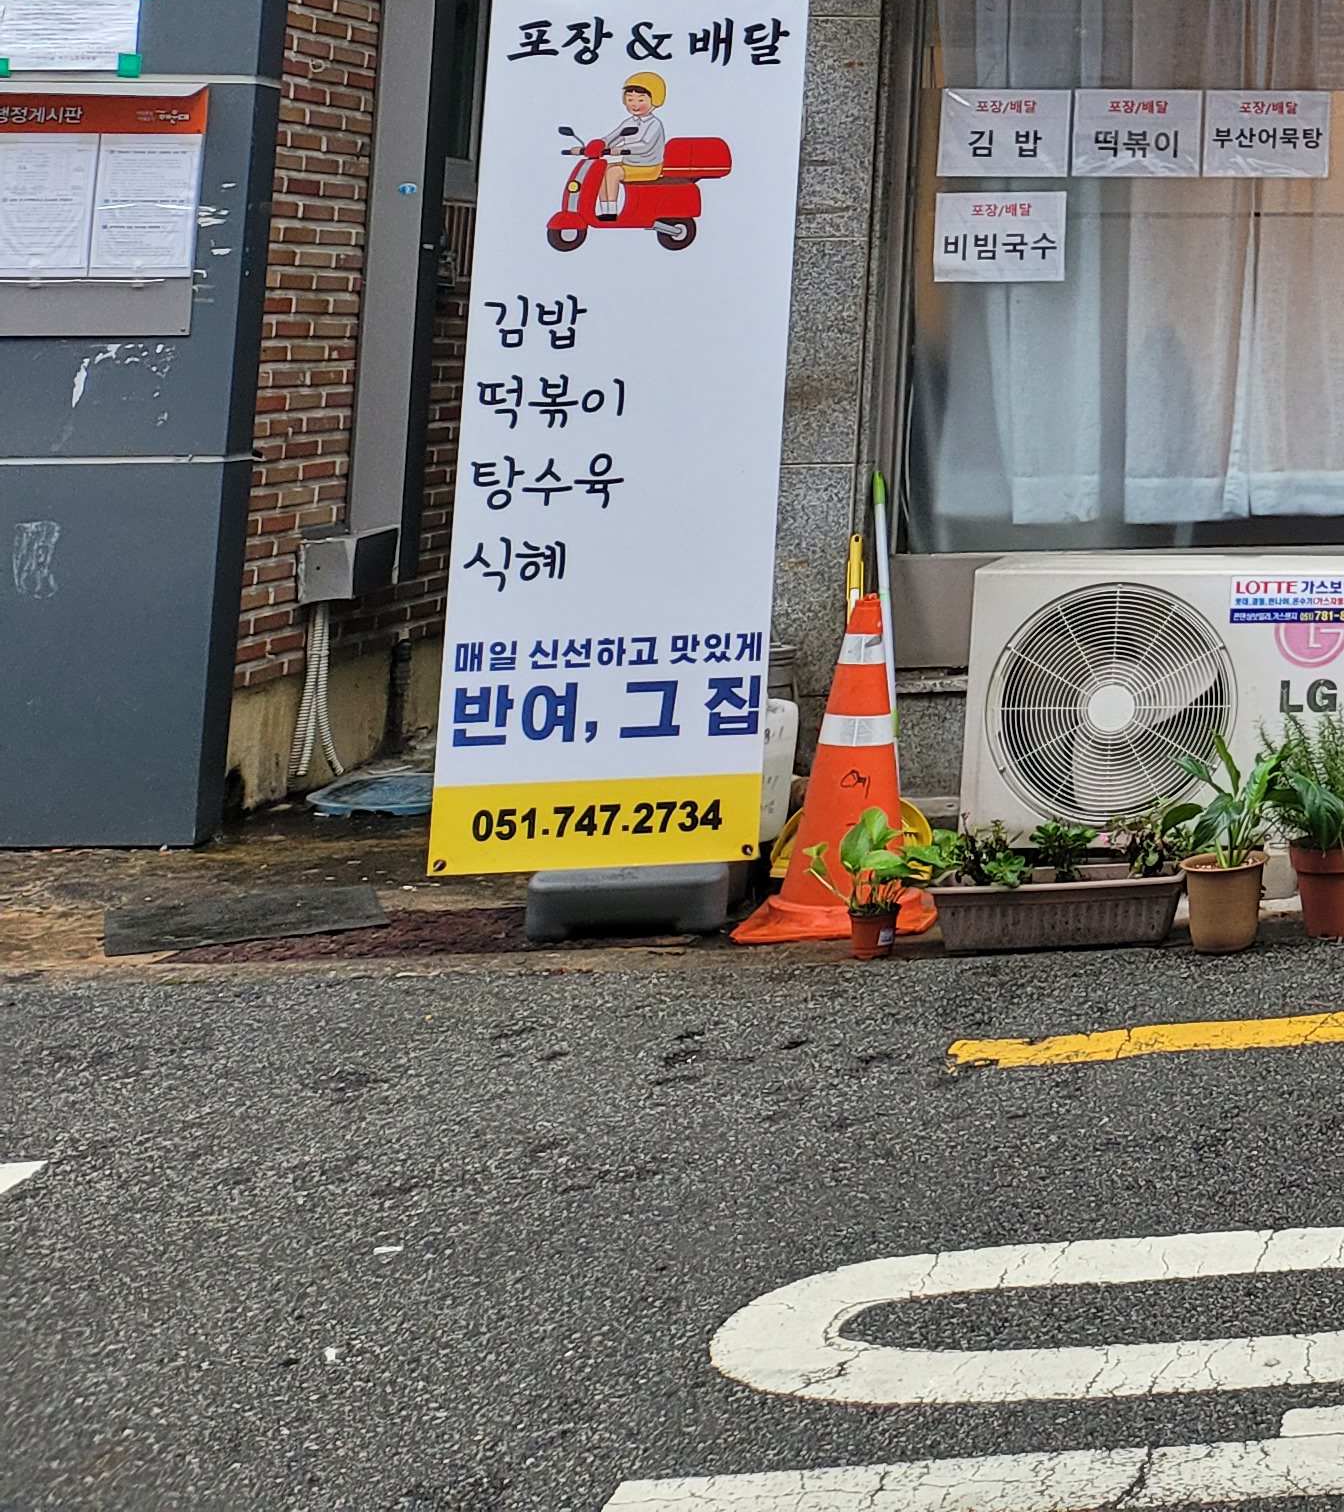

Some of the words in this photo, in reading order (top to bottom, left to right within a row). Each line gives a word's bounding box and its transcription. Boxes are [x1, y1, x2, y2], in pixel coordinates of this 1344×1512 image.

[506, 16, 613, 65] 포장
[626, 21, 673, 62] &
[688, 17, 790, 67] 배달
[976, 99, 1037, 115] 포장/배달
[1109, 100, 1169, 115] 포장/배달
[1239, 101, 1298, 115] 포장/배달
[1094, 129, 1179, 159] 떡볶이
[1212, 126, 1323, 150] 부산어묵탕
[971, 203, 1032, 218] 포장/배달
[943, 232, 1058, 261] 비빔국수
[484, 294, 588, 350] 김밥
[476, 374, 626, 429] 떡볶이
[471, 453, 625, 510] 탕수육
[463, 537, 566, 592] 식혜
[1235, 581, 1298, 594] LOTTE
[454, 641, 518, 673] 매일
[528, 636, 659, 670] 신선하고
[669, 632, 763, 666] 맛있게
[452, 681, 599, 748] 반여,
[619, 680, 680, 739] 그
[704, 675, 761, 737] 집
[1279, 679, 1338, 713] LG
[471, 799, 723, 842] 051.747.2734
